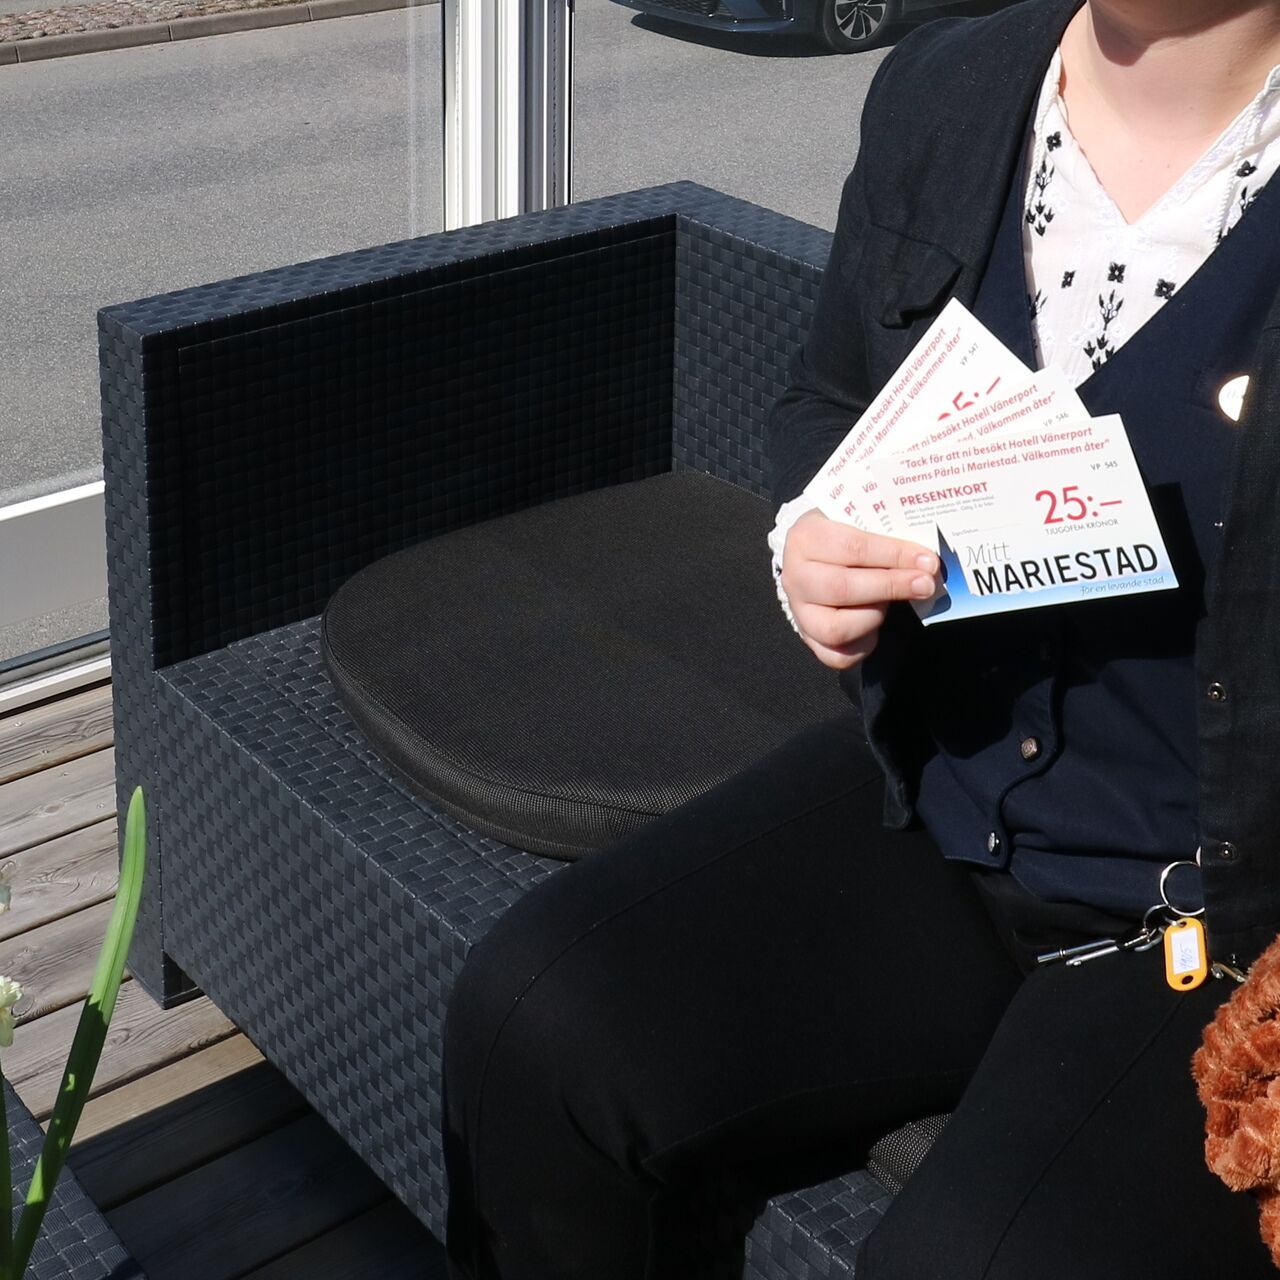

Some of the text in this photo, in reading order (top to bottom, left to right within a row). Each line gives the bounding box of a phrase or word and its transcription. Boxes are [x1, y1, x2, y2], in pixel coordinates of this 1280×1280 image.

[856, 431, 868, 446] att
[865, 421, 874, 434] ni
[871, 394, 896, 424] besökt
[892, 367, 915, 397] Hotell
[911, 328, 946, 371] Vänerport
[907, 351, 948, 400] Välkommen
[921, 437, 930, 448] ni
[930, 422, 962, 443] besökt
[962, 406, 990, 428] Hotell
[990, 384, 1039, 413] Vänerport
[976, 405, 1032, 436] Välkommen
[929, 453, 943, 464] för
[945, 450, 960, 461] att
[962, 447, 972, 458] ni
[973, 442, 1007, 456] besökt
[1008, 435, 1039, 449] Hotell
[1040, 427, 1093, 444] Vänerport
[892, 471, 933, 486] Vänerns
[934, 465, 960, 478] Pärla
[967, 454, 1020, 472] Mariestad.
[1022, 445, 1082, 462] Välkommen
[1090, 460, 1118, 471] VP 545
[899, 481, 988, 507] PRESENTKORT
[1045, 518, 1119, 536] TJUGOFEM KRONOR
[966, 541, 1011, 568] Mitt
[972, 543, 1158, 596] MARIESTAD
[1095, 583, 1107, 592] en
[1107, 578, 1143, 590] levande
[1143, 575, 1165, 586] stad
